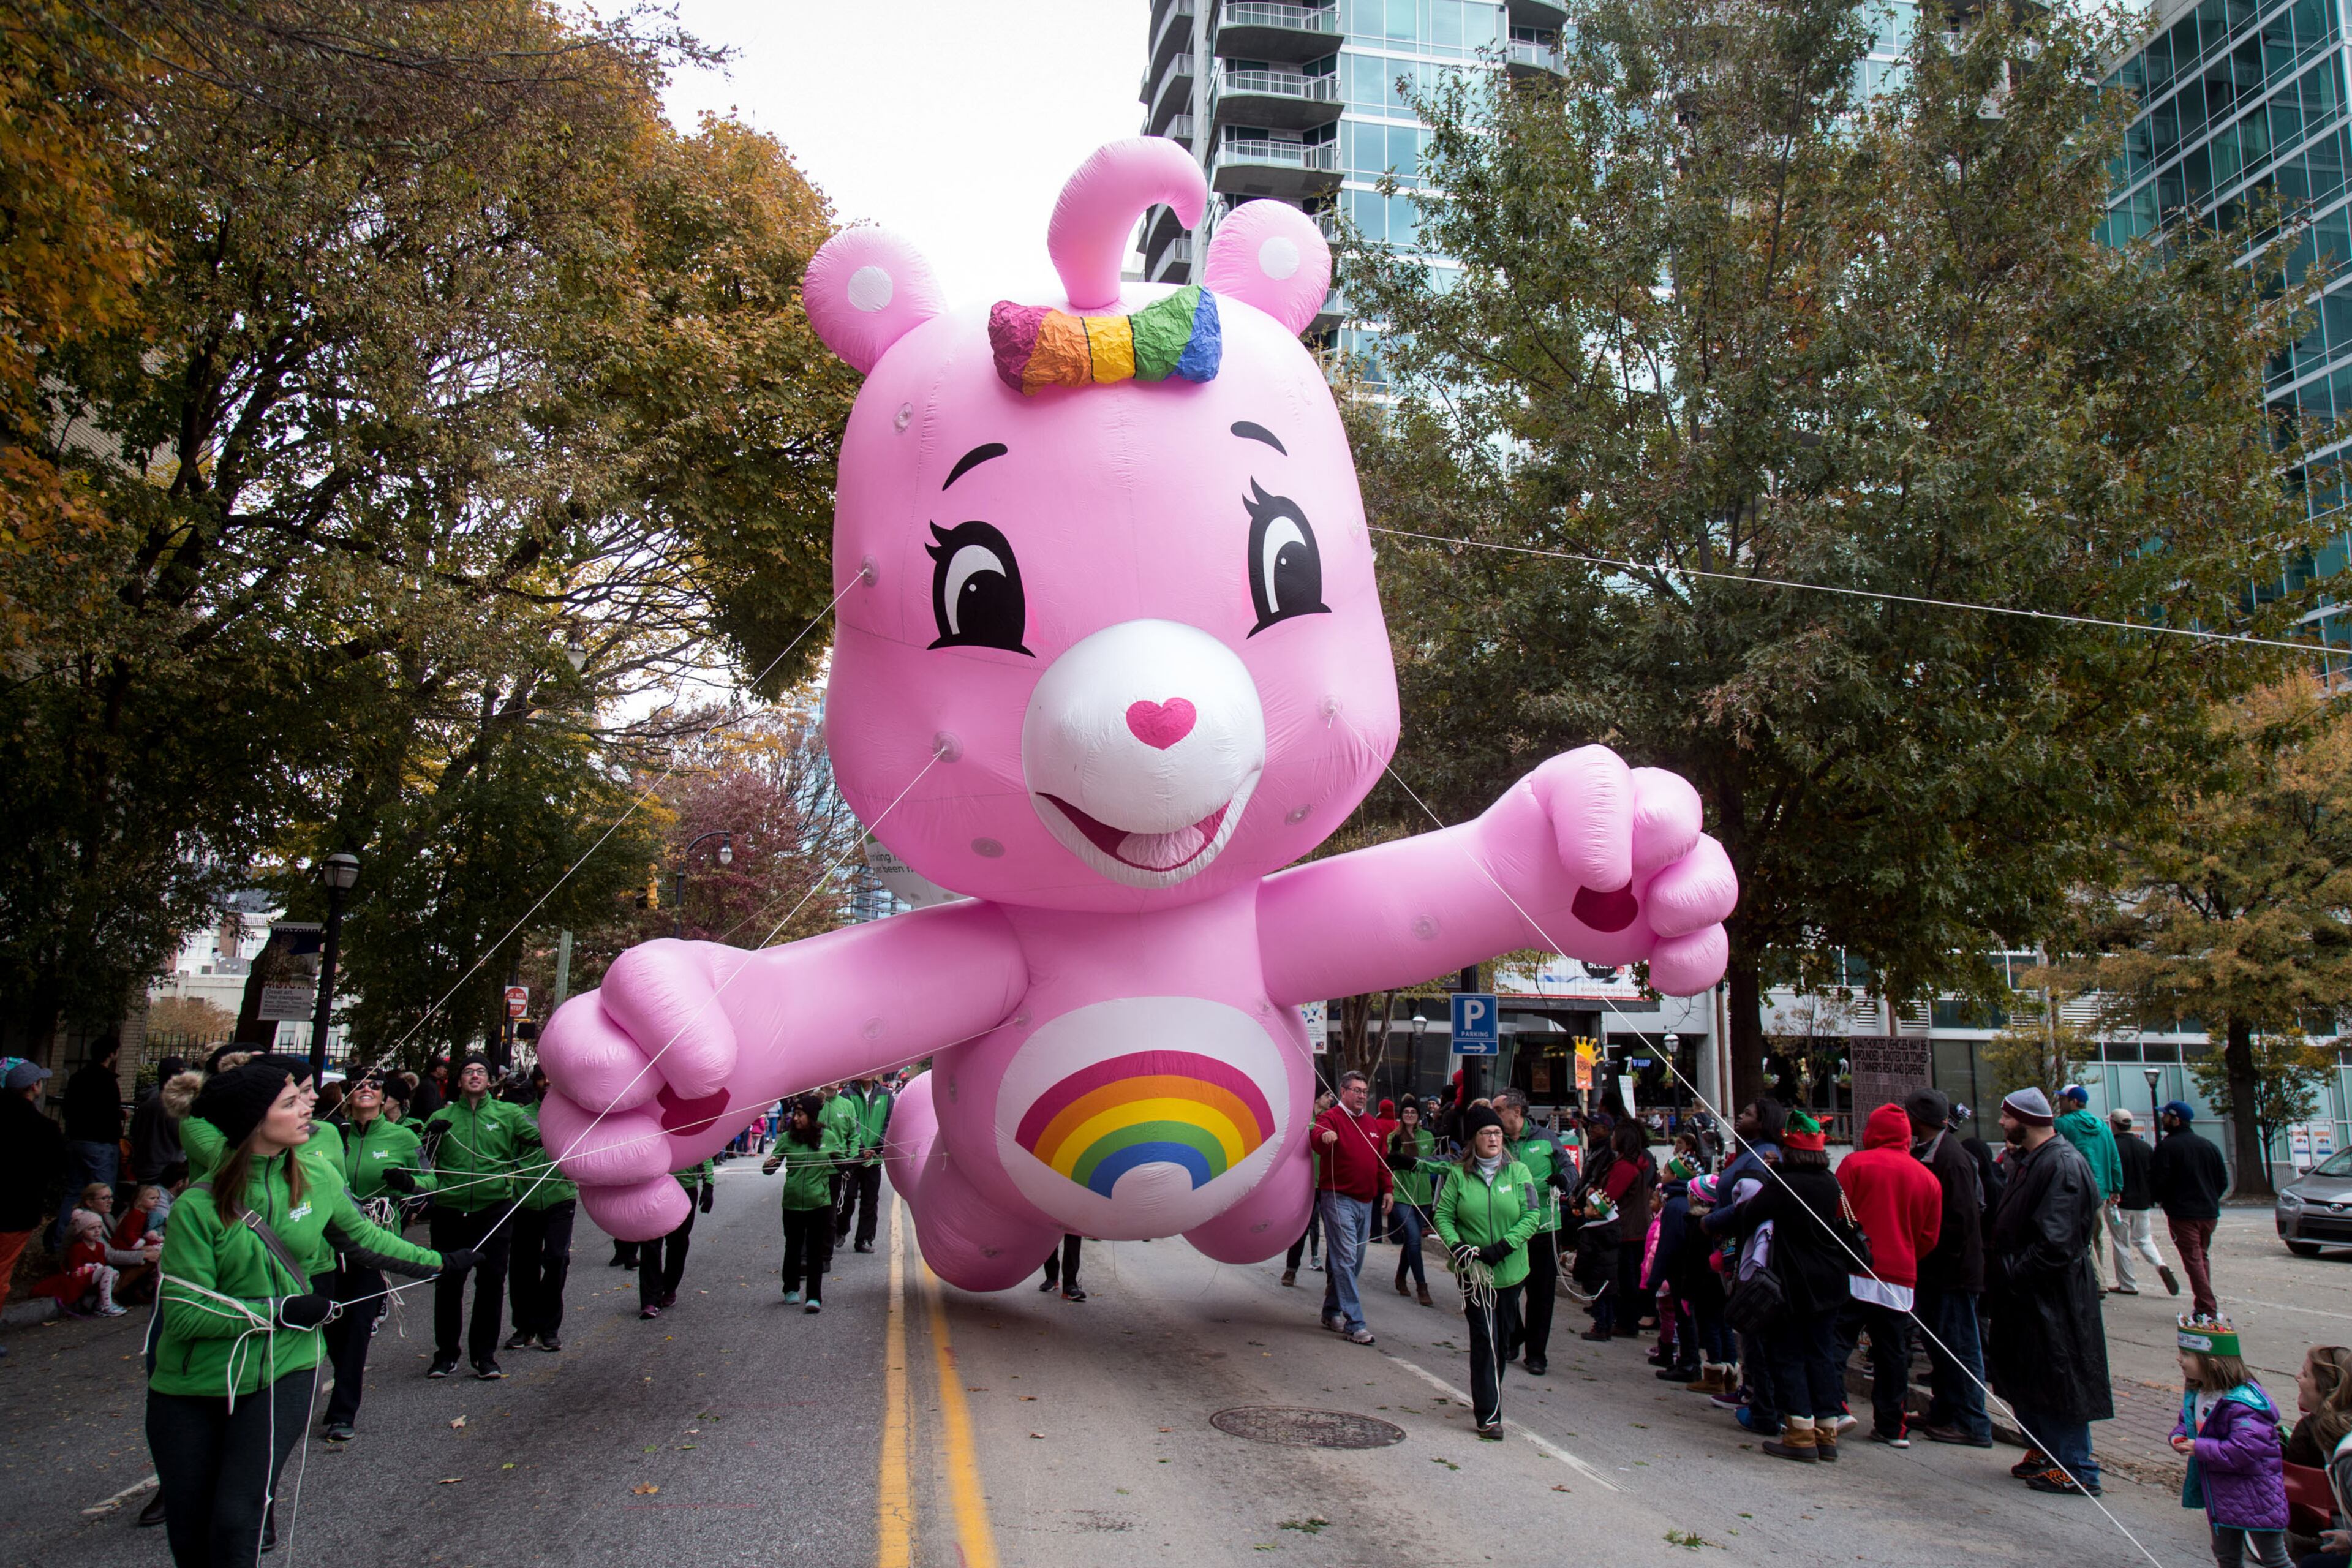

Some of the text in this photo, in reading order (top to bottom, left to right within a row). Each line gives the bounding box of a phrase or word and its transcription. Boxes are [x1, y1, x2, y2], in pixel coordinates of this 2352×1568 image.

[882, 864, 904, 873] been
[1464, 1000, 1485, 1030] P
[1852, 1038, 1926, 1051] UNAUTHORIZED VEHICLES MAY BE
[1852, 1050, 1879, 1061] IMPOUNDED
[1883, 1050, 1901, 1061] BOOTED
[1902, 1051, 1909, 1062] OR
[1910, 1051, 1927, 1063] TOWED
[1855, 1061, 1861, 1071] AT
[1883, 1062, 1893, 1073] RISK
[1894, 1063, 1904, 1074] AND
[1905, 1063, 1925, 1076] EXPENSE
